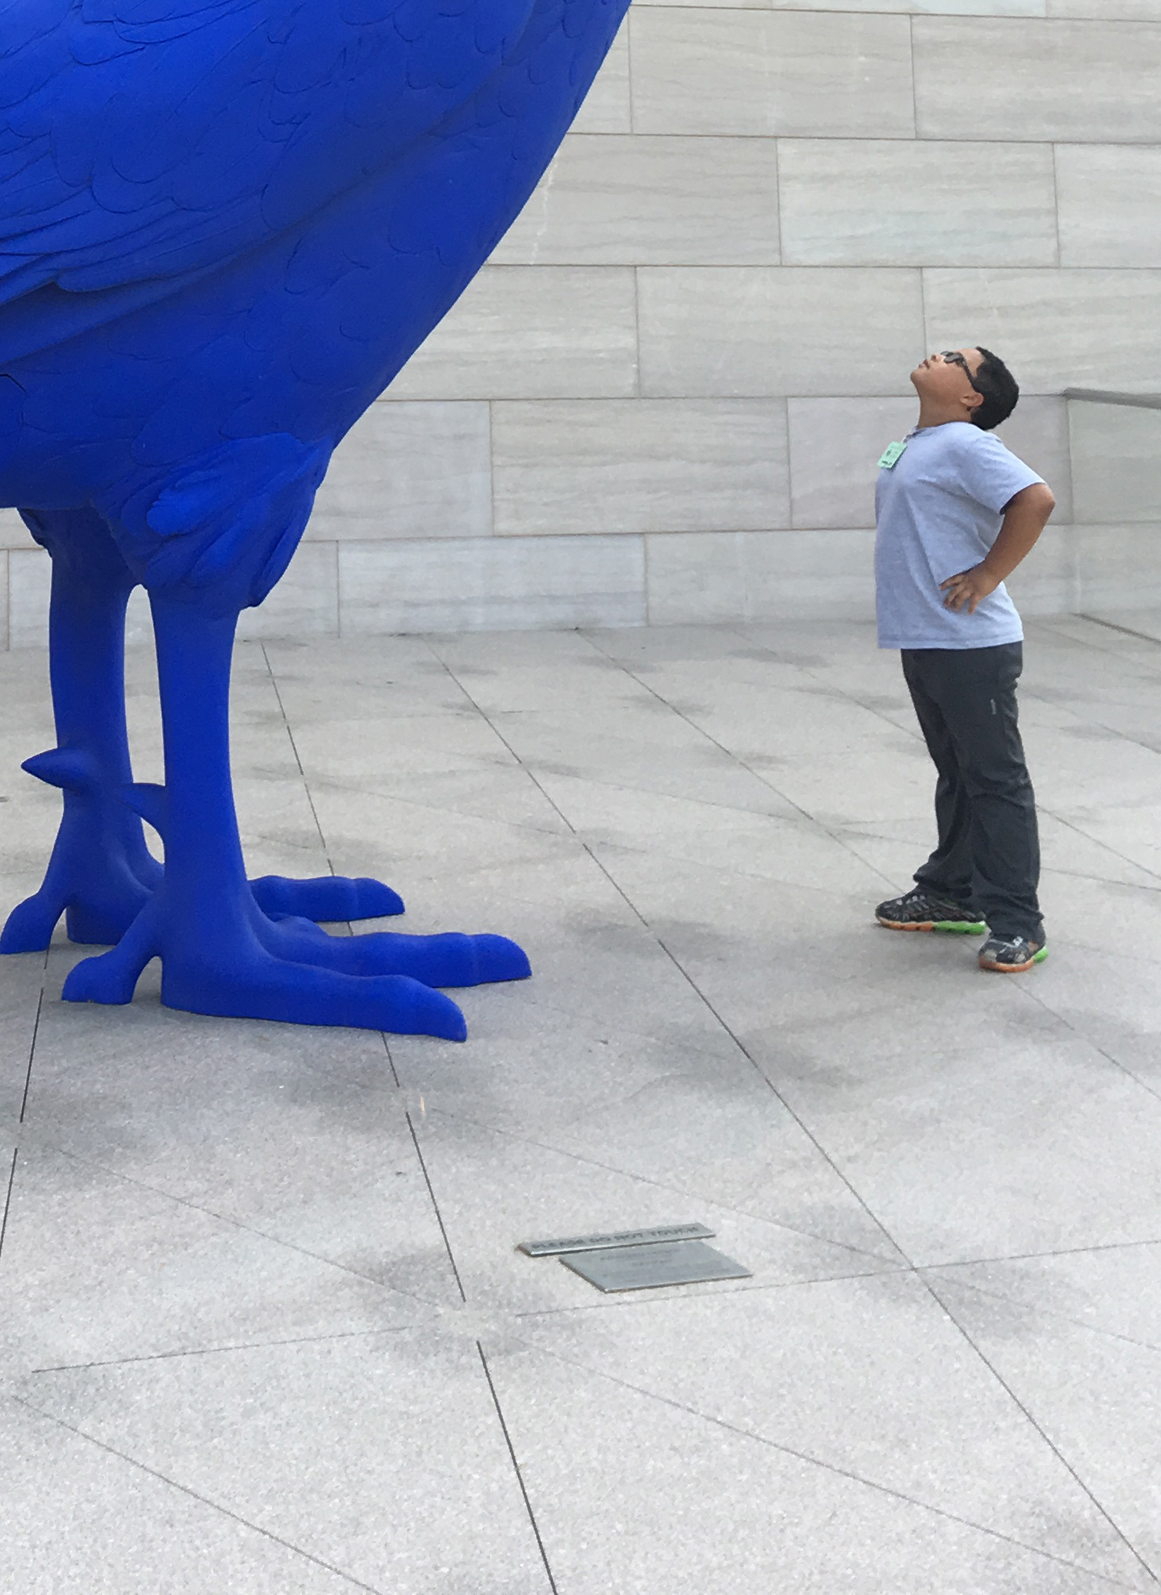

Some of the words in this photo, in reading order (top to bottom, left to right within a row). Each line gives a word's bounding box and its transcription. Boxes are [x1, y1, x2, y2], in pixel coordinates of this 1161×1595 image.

[589, 1236, 612, 1244] DO
[614, 1232, 644, 1242] NOT
[650, 1226, 699, 1238] TOUCH
